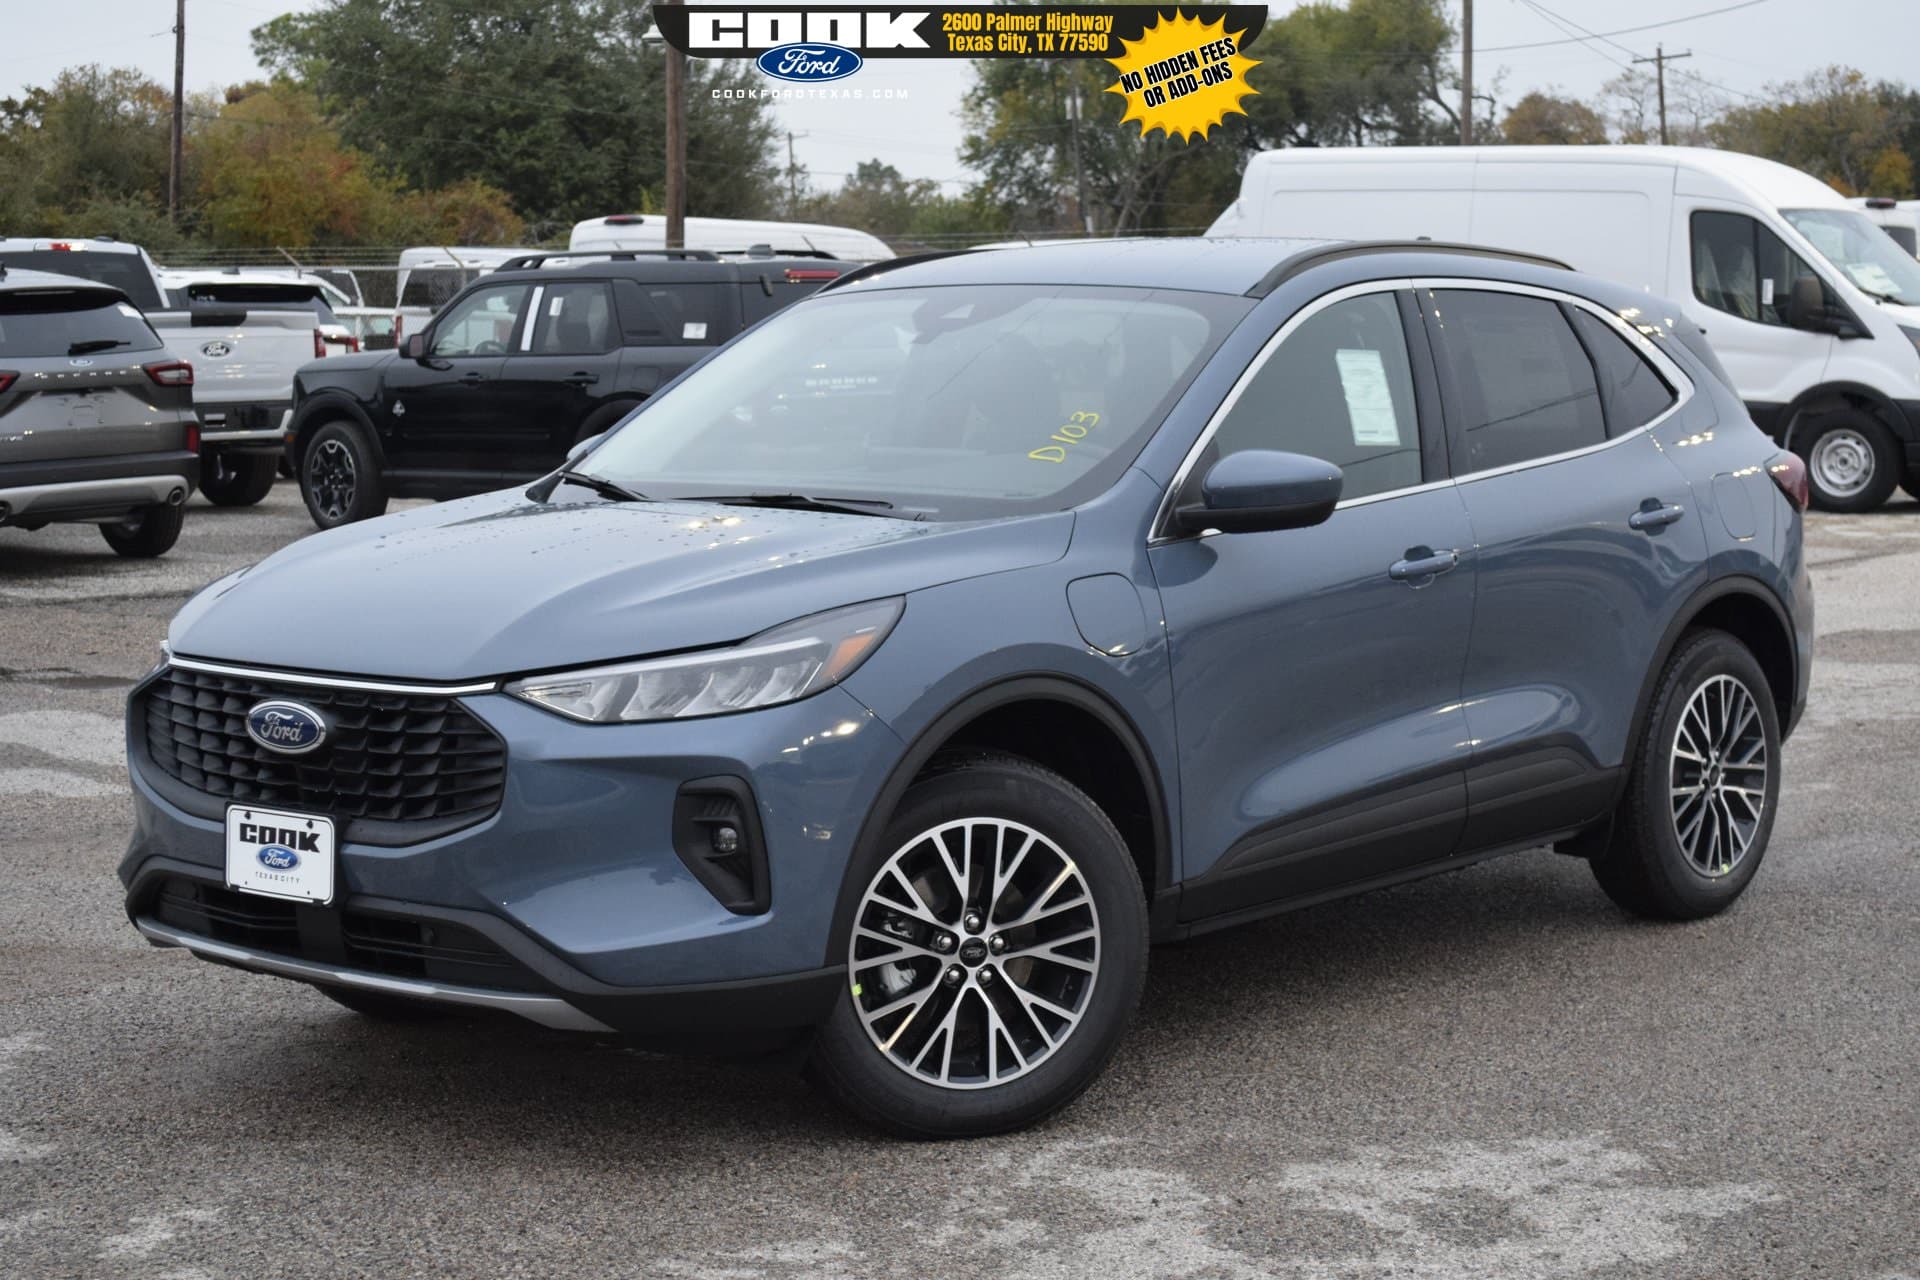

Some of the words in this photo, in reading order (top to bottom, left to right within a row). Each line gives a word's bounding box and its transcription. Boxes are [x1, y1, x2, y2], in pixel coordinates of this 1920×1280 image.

[260, 711, 304, 742] Ford
[239, 822, 321, 854] COOK
[264, 848, 292, 868] Ford
